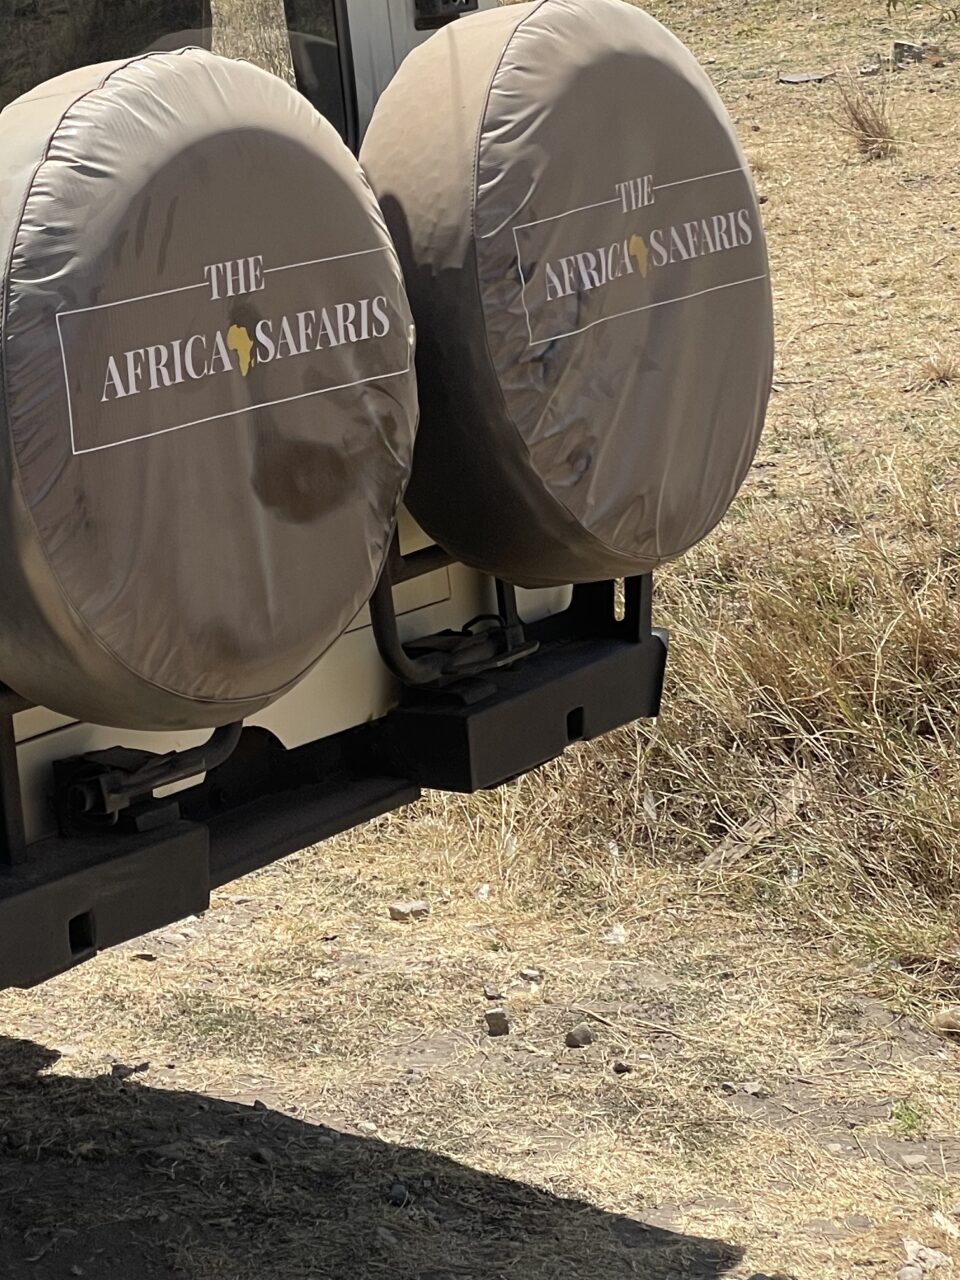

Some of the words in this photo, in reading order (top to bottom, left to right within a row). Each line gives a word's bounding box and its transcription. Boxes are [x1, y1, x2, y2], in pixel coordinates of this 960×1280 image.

[614, 174, 655, 214] THE
[203, 255, 266, 302] THE
[544, 239, 634, 302] AFRICA
[649, 208, 753, 268] SAFARIS
[100, 330, 234, 403] AFRICA
[254, 295, 390, 365] SAFARIS
